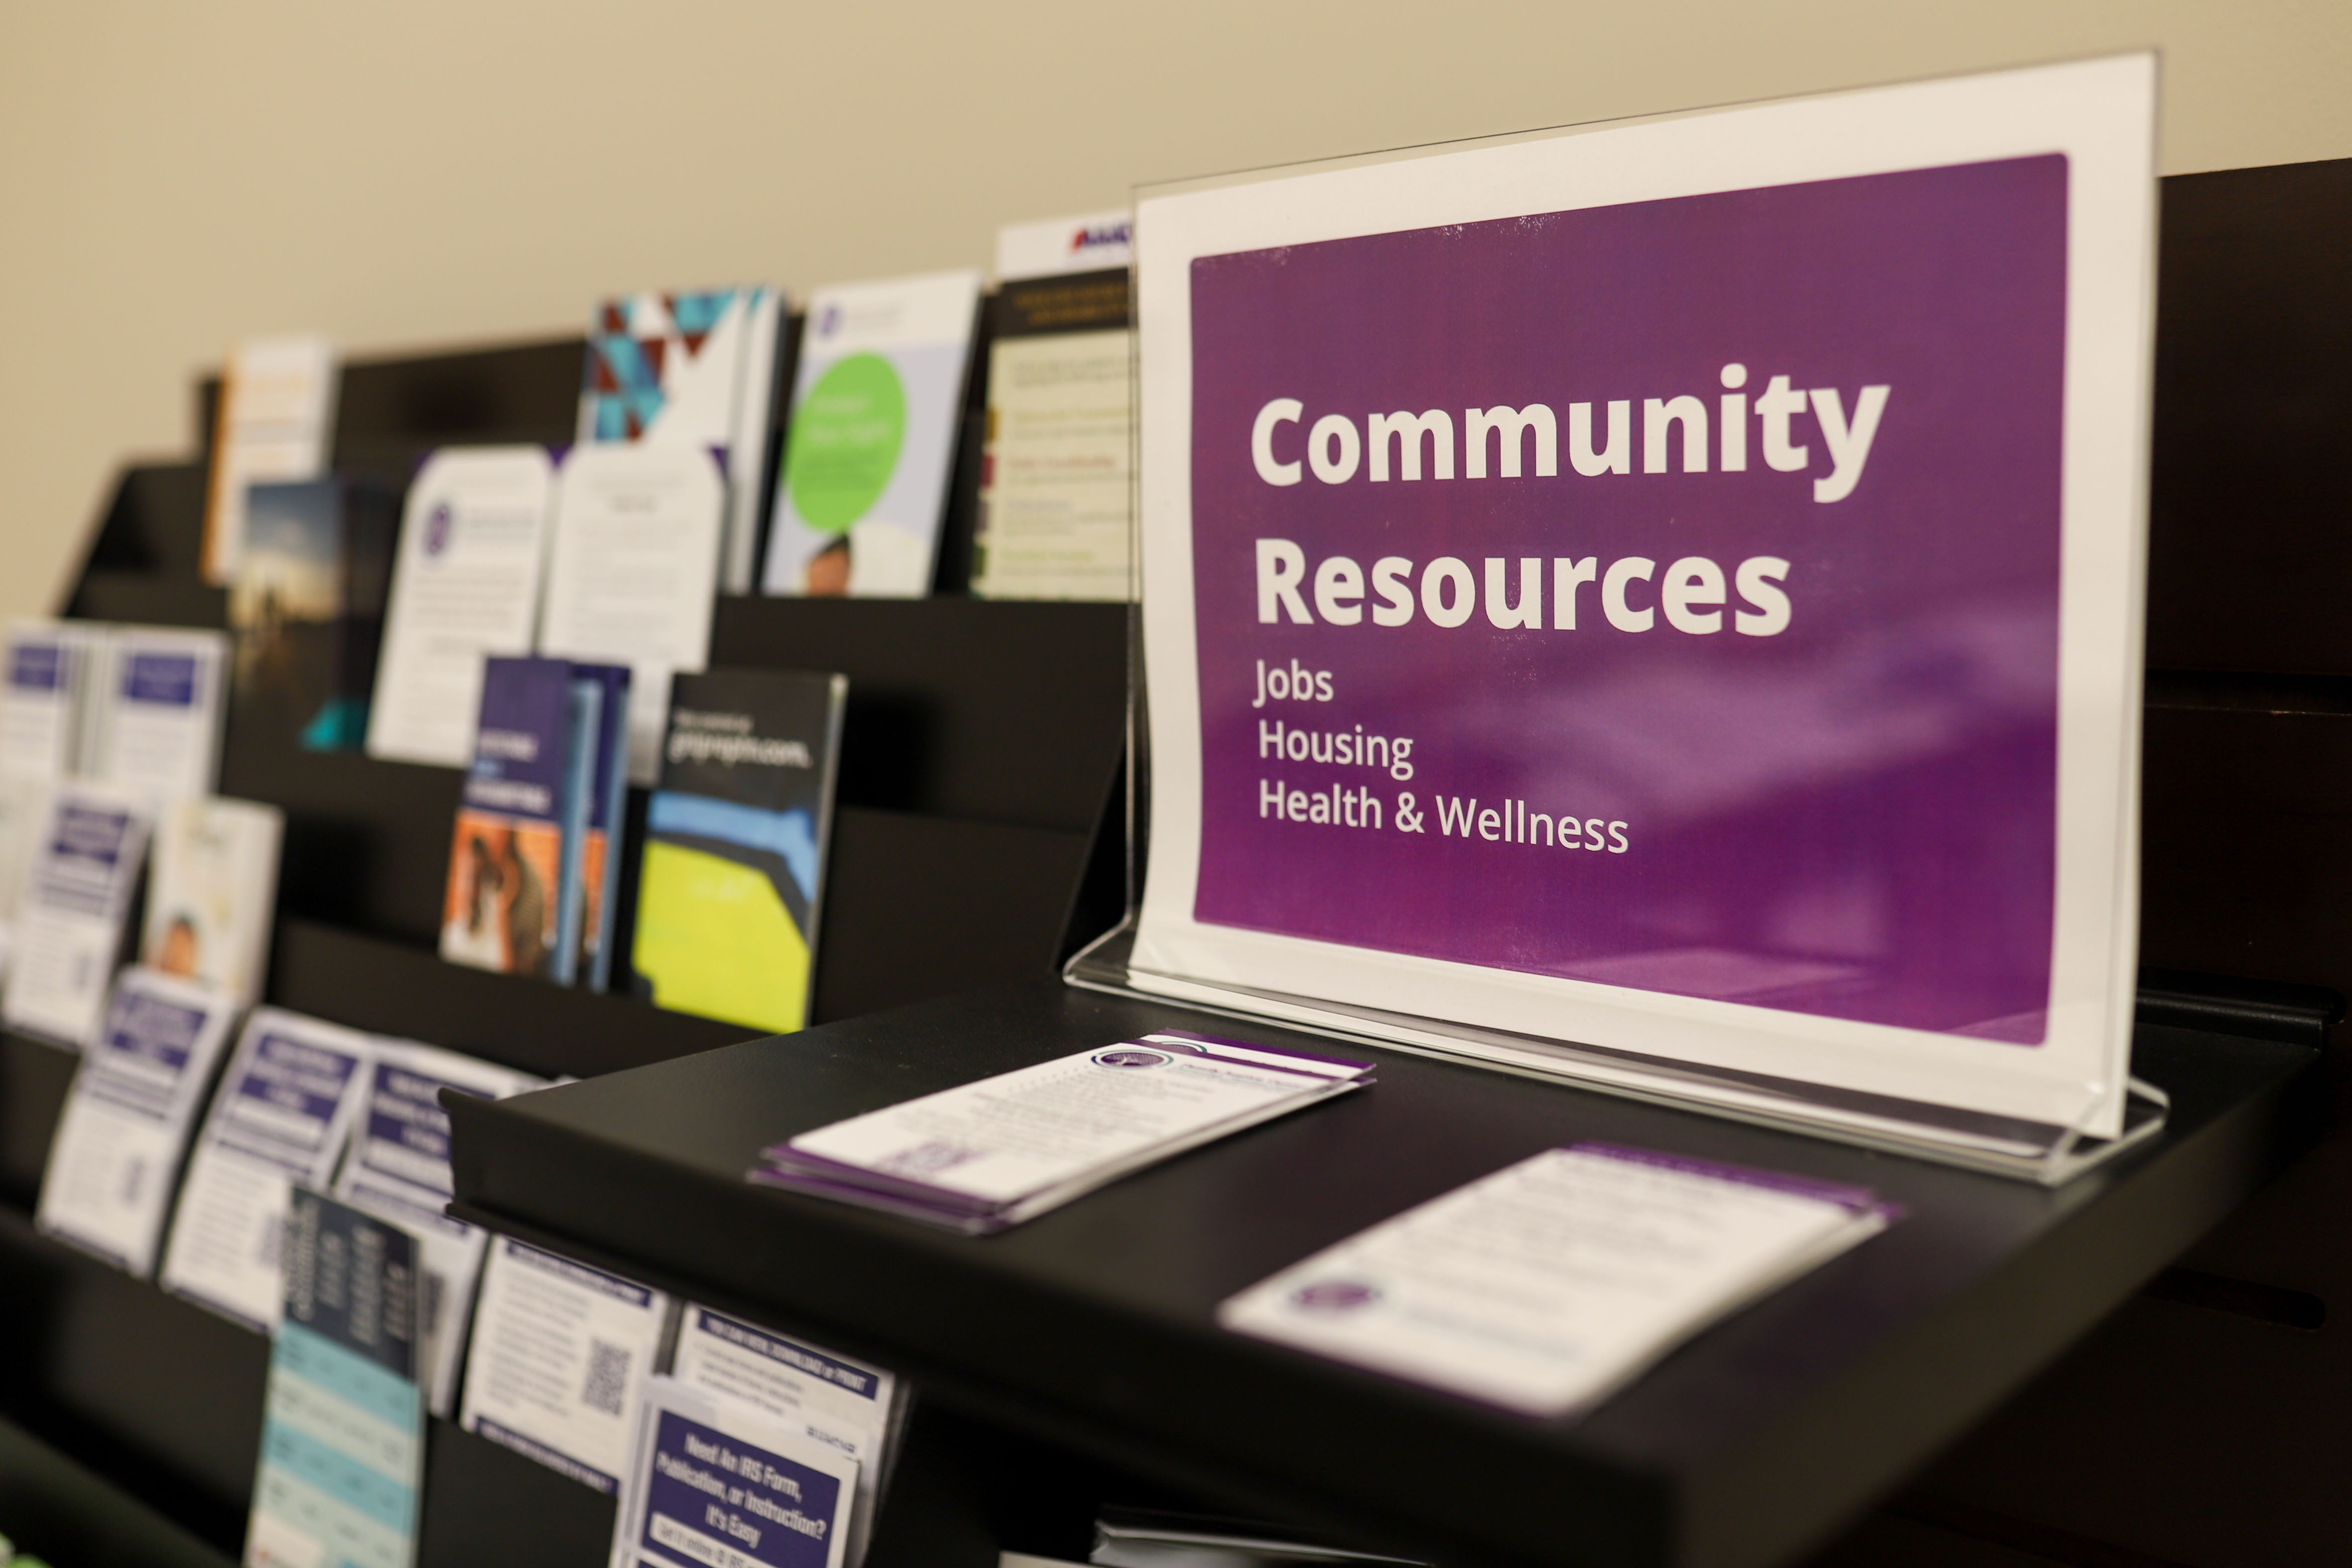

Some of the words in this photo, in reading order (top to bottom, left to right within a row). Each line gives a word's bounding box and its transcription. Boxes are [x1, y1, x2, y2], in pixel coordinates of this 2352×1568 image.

[1251, 363, 1891, 503] Community
[1255, 539, 1792, 637] Resources
[1253, 659, 1334, 707] Jobs
[1259, 720, 1414, 780] Housing
[1260, 780, 1382, 829] Health
[1395, 792, 1425, 833] &
[1436, 795, 1629, 853] Wellness
[656, 1451, 728, 1504] Publication,
[727, 1486, 745, 1506] or
[744, 1489, 827, 1540] Instruction?
[684, 1432, 721, 1465] Need
[719, 1447, 739, 1472] An
[738, 1455, 764, 1483] IRS
[763, 1465, 802, 1503] Form,
[705, 1503, 728, 1532] It's
[727, 1513, 762, 1549] Easy
